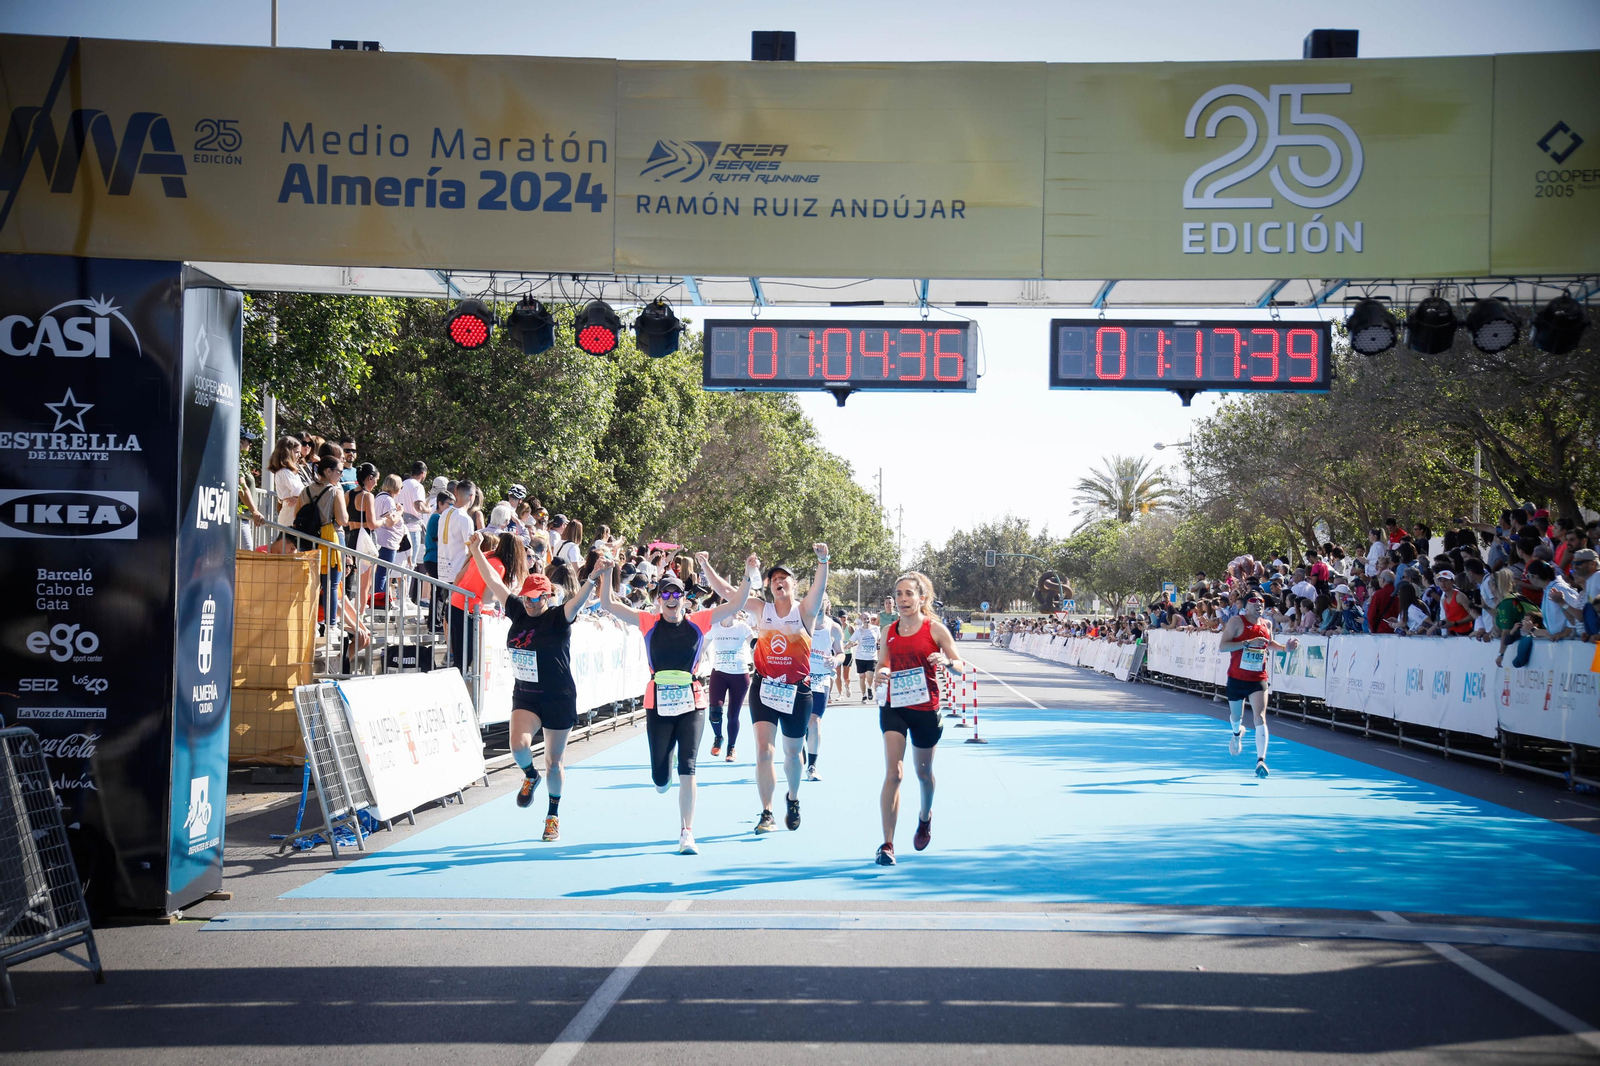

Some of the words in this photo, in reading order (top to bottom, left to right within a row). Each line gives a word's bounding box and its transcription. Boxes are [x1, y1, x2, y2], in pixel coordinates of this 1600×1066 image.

[194, 118, 243, 152] 25
[281, 122, 409, 158] Medio
[431, 128, 607, 163] Maratón
[721, 143, 789, 160] RFEA
[1183, 83, 1364, 209] 25
[193, 153, 243, 165] EDICIÓN
[714, 160, 781, 173] SERIES
[708, 173, 742, 184] RUTA
[754, 174, 820, 184] RUNNING
[1535, 169, 1600, 183] COOPER
[277, 163, 466, 210] Almería
[478, 169, 608, 213] 2024
[1535, 184, 1575, 198] 2005
[636, 191, 740, 216] RAMÓN
[753, 197, 818, 217] RUIZ
[830, 194, 967, 220] ANDÚJAR
[1182, 213, 1364, 254] EDICIÓN
[0, 315, 111, 358] CASI
[748, 327, 965, 382] 01:04:36
[1096, 326, 1319, 383] 01:17:39
[194, 374, 234, 400] COOPERACIÓN
[194, 390, 209, 407] 2005
[0, 432, 142, 452] ESTRELLA
[28, 451, 47, 460] DE
[48, 451, 109, 461] LEVANTE
[14, 503, 122, 525] IKEA
[37, 568, 93, 581] Barceló
[36, 582, 73, 596] Cabo
[76, 583, 94, 596] de
[36, 597, 70, 610] Gata
[26, 623, 100, 663] ego
[72, 655, 86, 663] sport
[512, 653, 534, 666] 5695
[1246, 652, 1264, 661] 1105
[18, 678, 59, 692] SER
[893, 674, 922, 689] 5389
[192, 681, 218, 702] ALMERÍA
[661, 688, 689, 700] 5697
[763, 685, 793, 698] 5069
[18, 709, 30, 718] La
[31, 709, 51, 718] Voz
[52, 709, 64, 718] de
[65, 709, 105, 719] Almería
[199, 702, 213, 714] CIUDAD
[19, 772, 98, 791] Analucía
